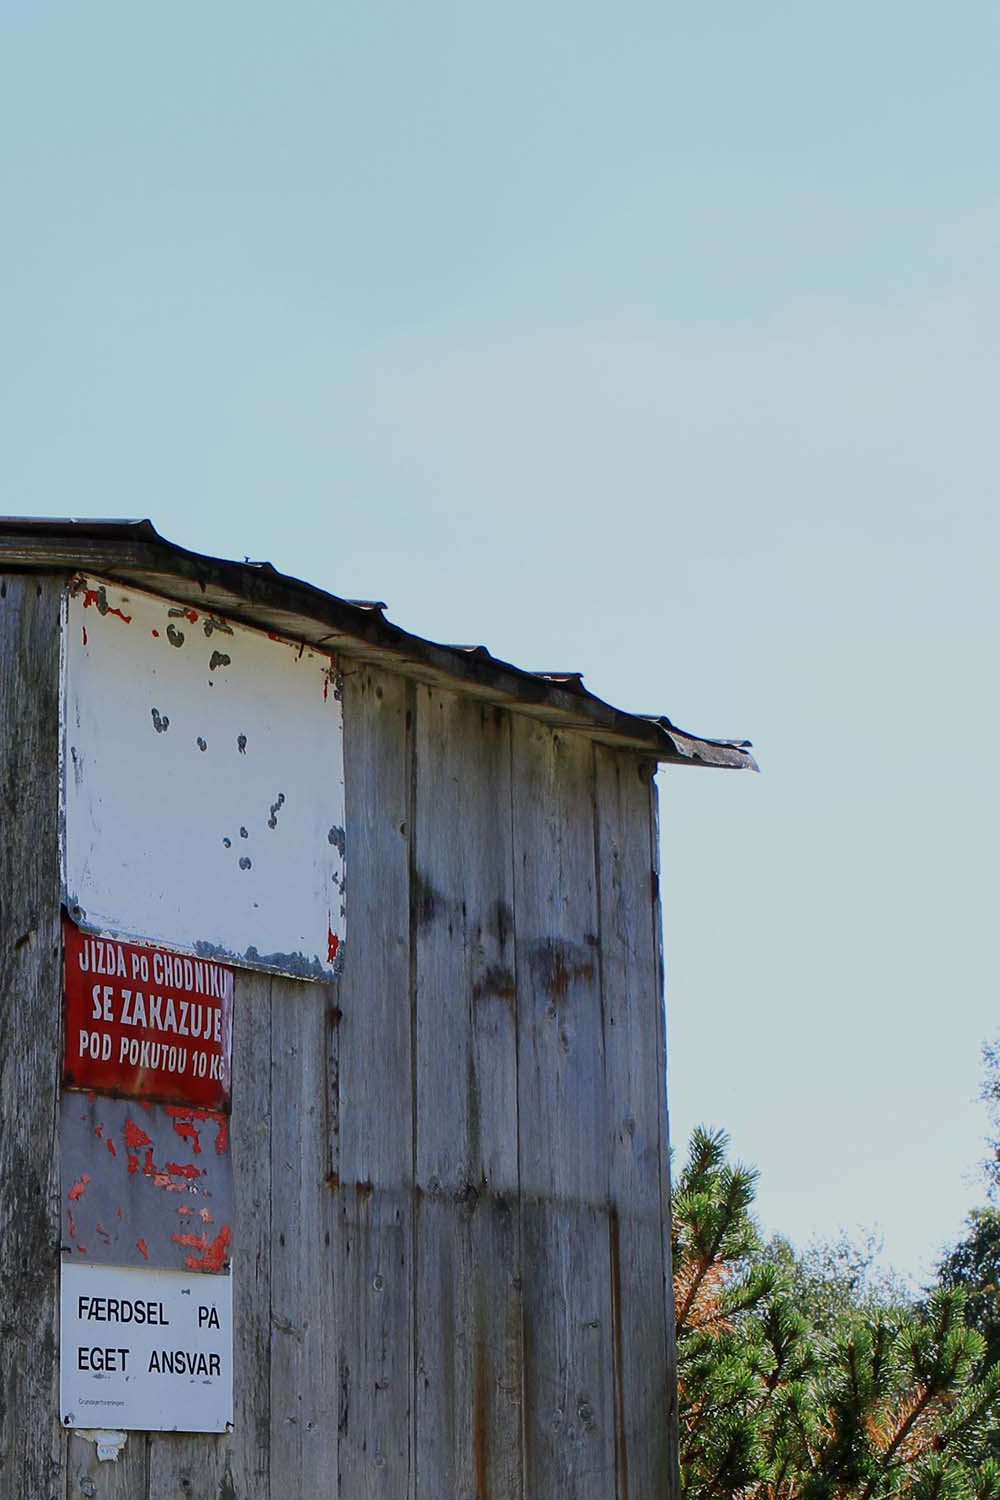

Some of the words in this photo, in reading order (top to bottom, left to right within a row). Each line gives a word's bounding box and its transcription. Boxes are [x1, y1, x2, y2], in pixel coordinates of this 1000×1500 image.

[131, 952, 149, 983] PO
[92, 984, 114, 1022] SE
[120, 989, 222, 1042] ZAKAZUJE
[79, 1029, 112, 1061] POD
[119, 1036, 187, 1074] POKUTOU
[192, 1050, 207, 1078] 10
[79, 1296, 169, 1325] FÆRDSEL
[79, 1348, 129, 1371] EGET
[149, 1351, 220, 1375] ANSVAR
